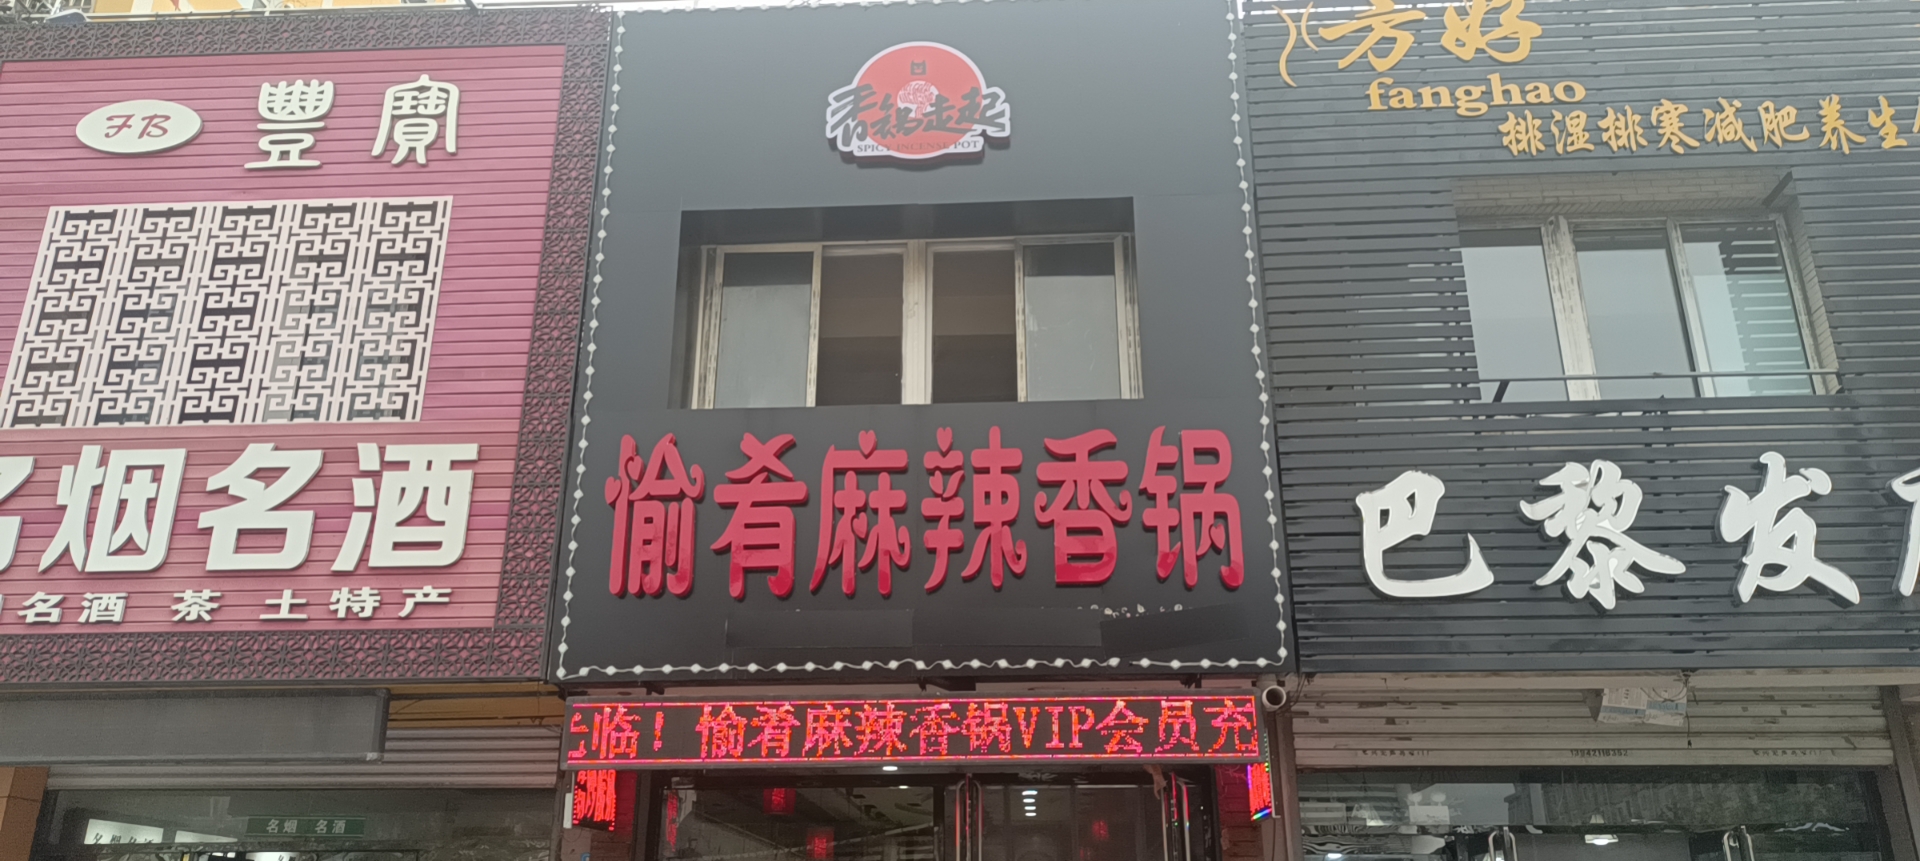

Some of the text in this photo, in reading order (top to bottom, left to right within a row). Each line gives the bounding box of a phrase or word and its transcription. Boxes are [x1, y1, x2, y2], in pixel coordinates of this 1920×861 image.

[1366, 73, 1587, 116] fanghao
[104, 113, 171, 139] FB
[1498, 95, 1920, 156] 排湿排寒减肥养生
[857, 140, 980, 153] SPICY INCENSE POT
[604, 425, 1245, 599] 愉肴麻辣香锅
[171, 589, 222, 622] 茶
[259, 586, 453, 623] 土特产
[266, 819, 346, 833] 名烟 名酒
